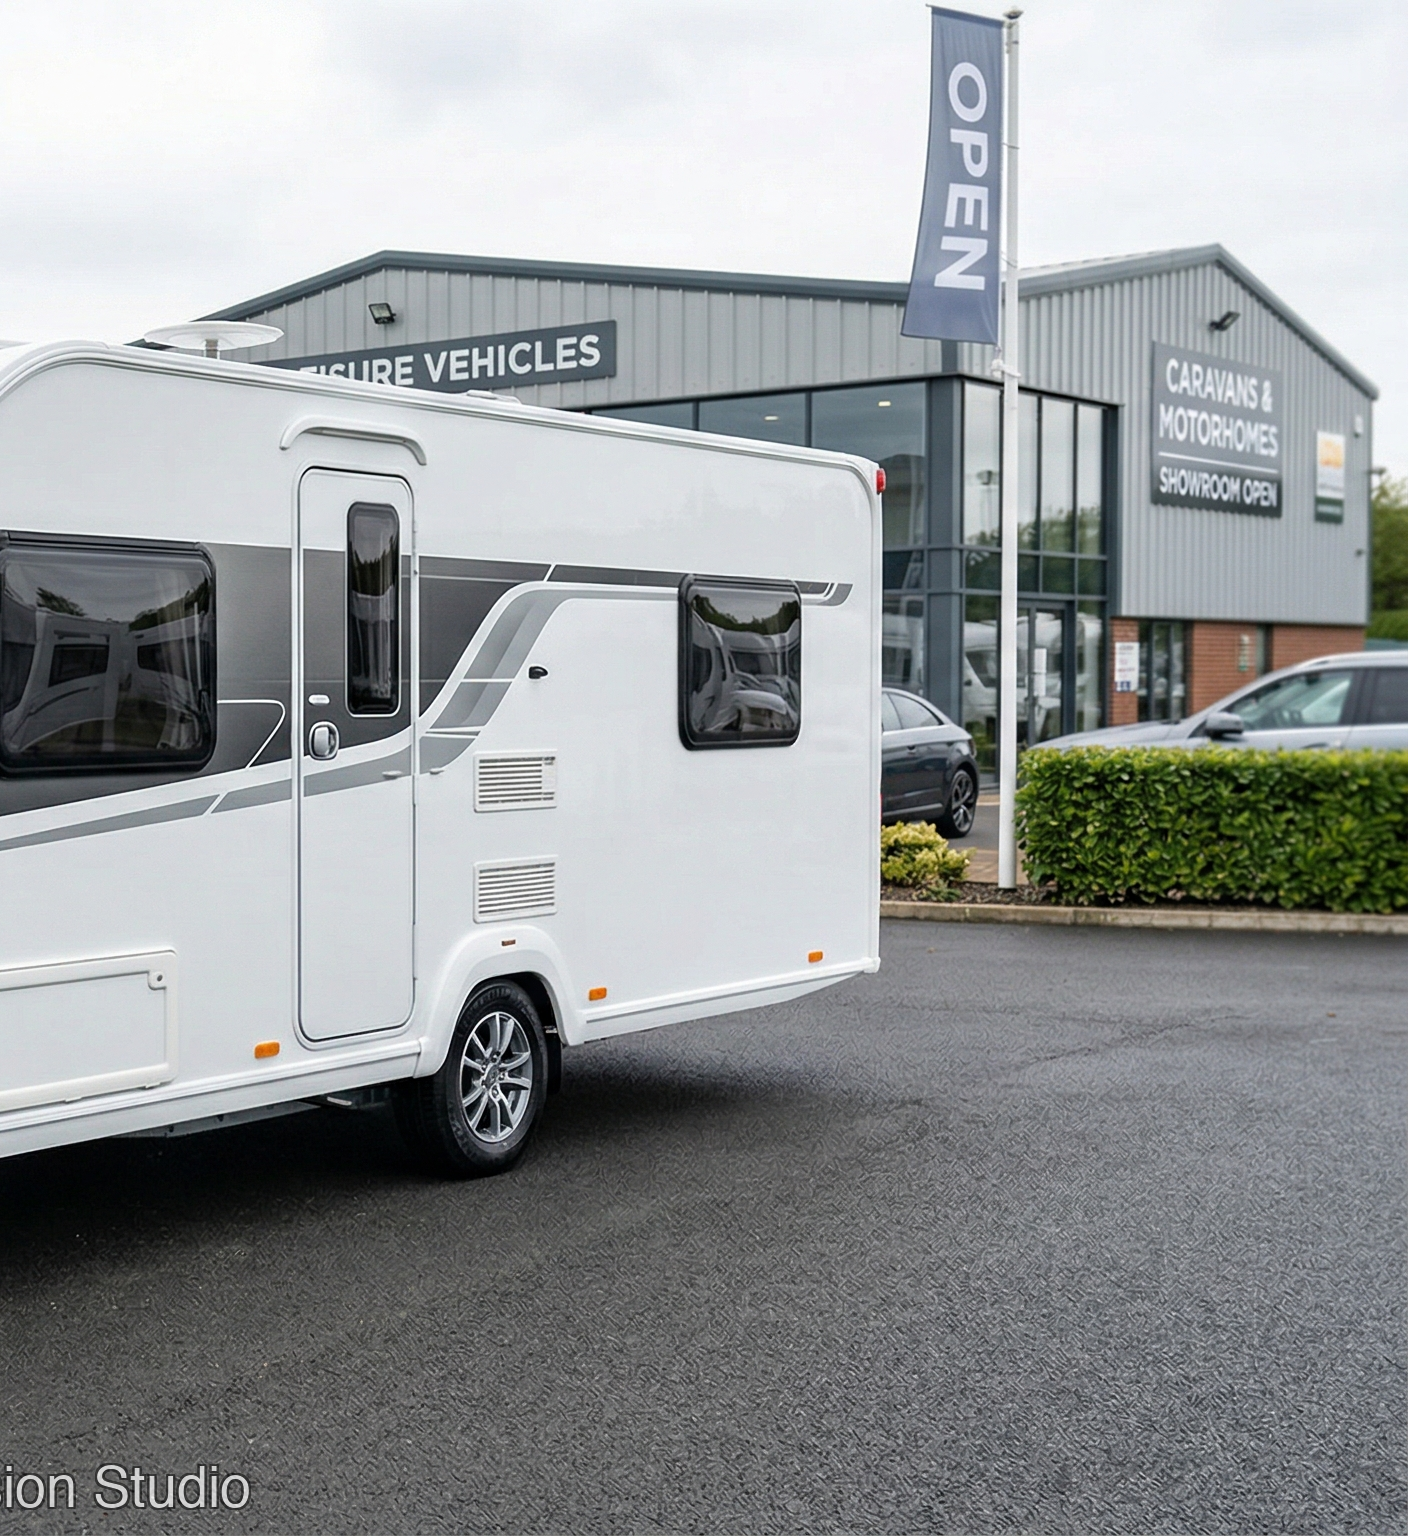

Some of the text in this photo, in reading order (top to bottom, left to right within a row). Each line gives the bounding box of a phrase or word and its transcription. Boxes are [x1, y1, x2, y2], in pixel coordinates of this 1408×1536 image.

[934, 61, 989, 291] OPEN
[424, 334, 601, 383] VEHICLES
[1166, 358, 1273, 413] CARAVANS &
[1159, 403, 1279, 457] MOTORHOMES
[1159, 466, 1278, 508] SHOWROOM OPEN
